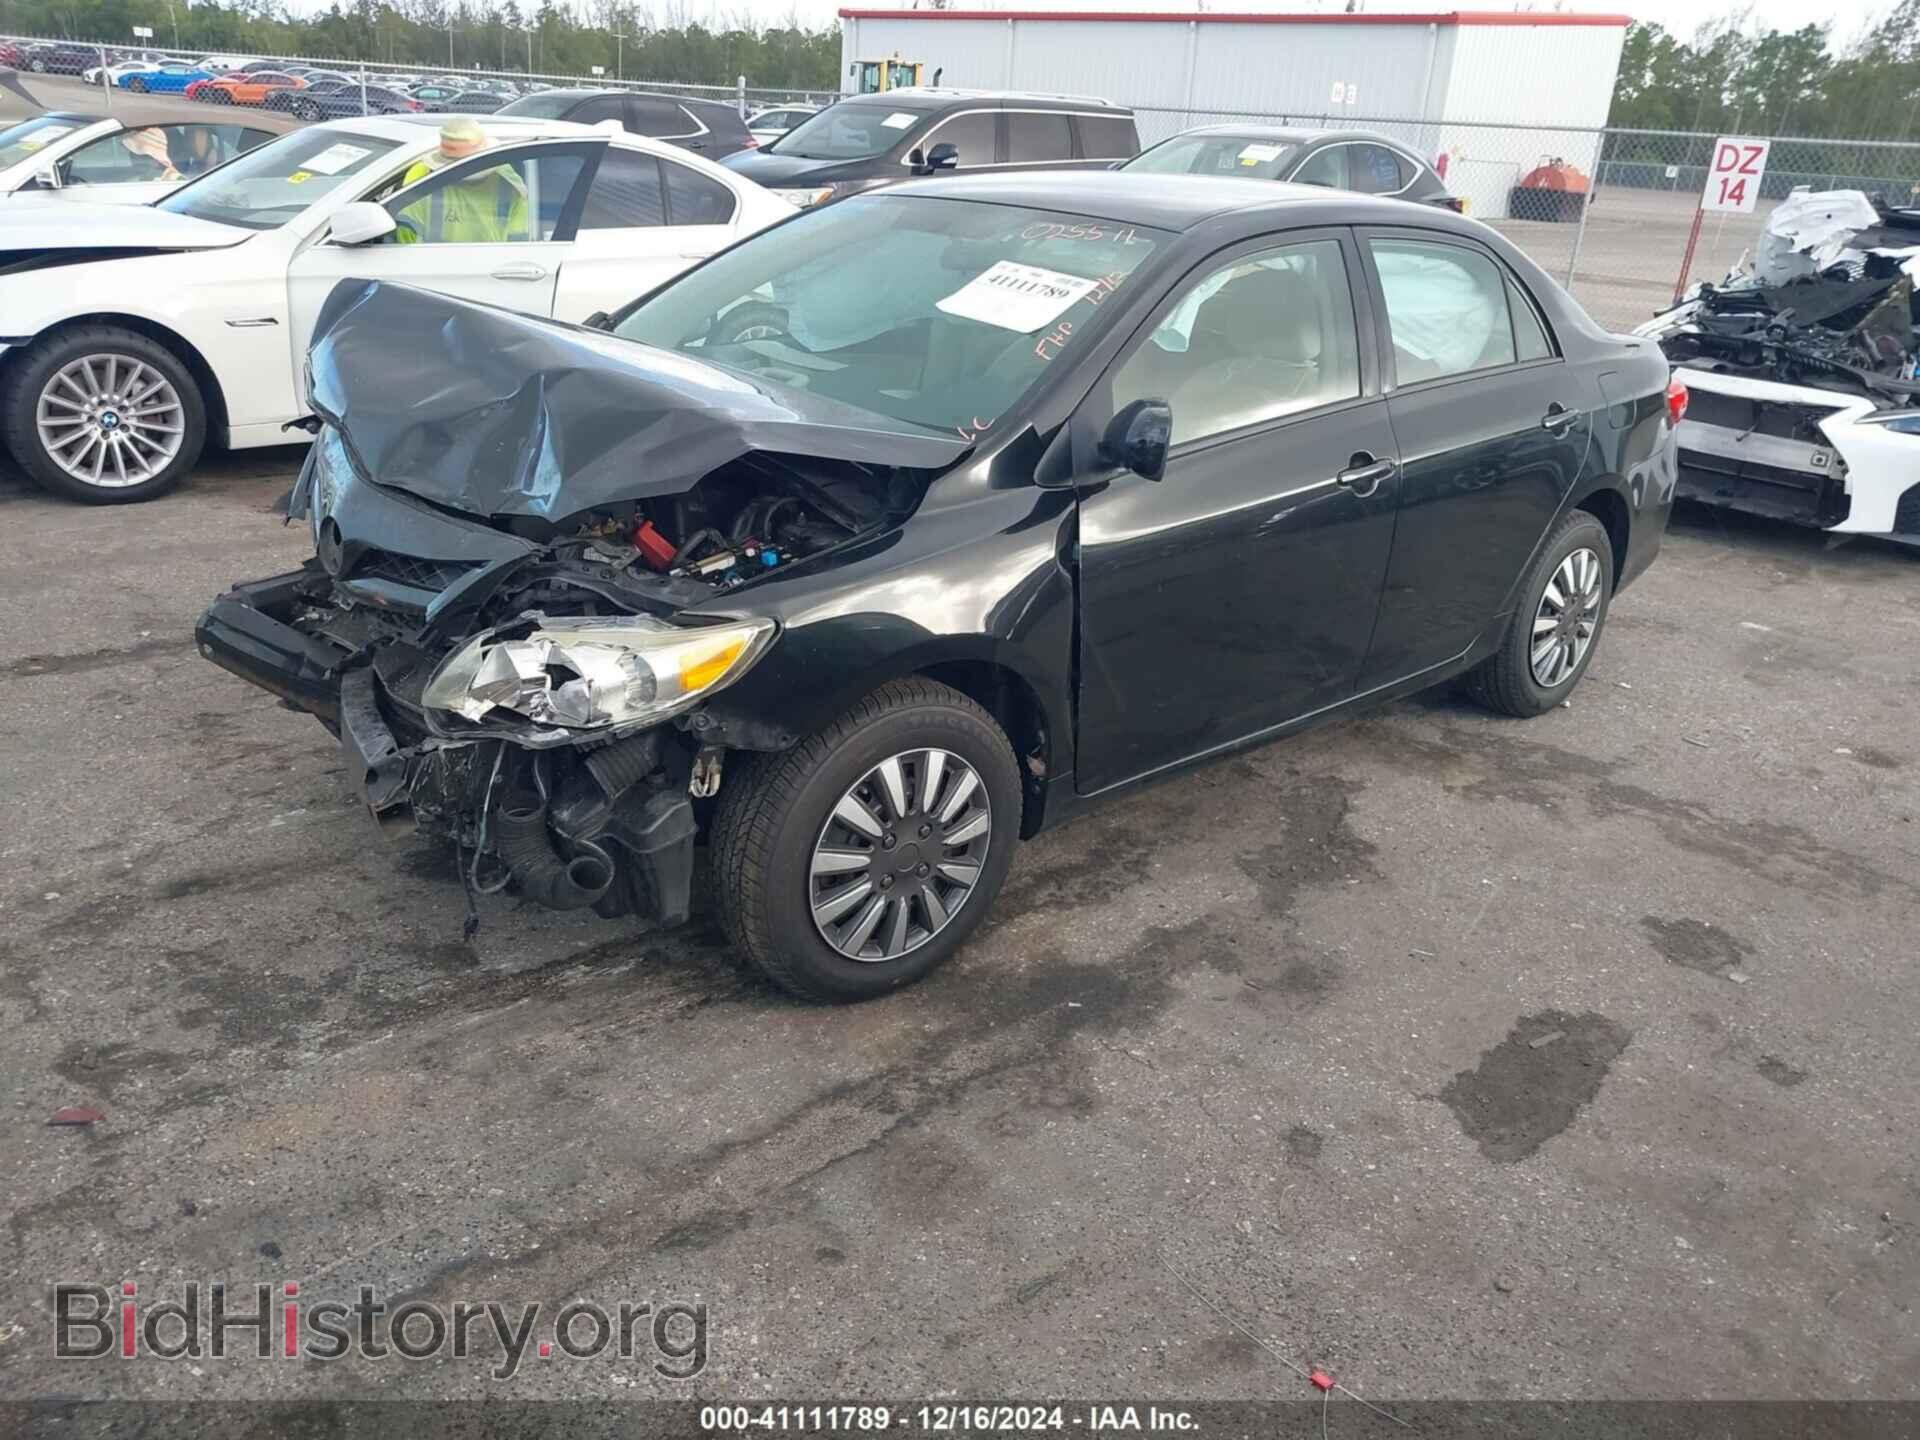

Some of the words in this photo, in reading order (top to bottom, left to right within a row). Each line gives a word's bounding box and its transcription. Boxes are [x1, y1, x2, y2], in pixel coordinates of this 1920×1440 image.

[1715, 144, 1764, 175] DZ
[1718, 176, 1747, 206] 14
[988, 274, 1071, 299] 41111789
